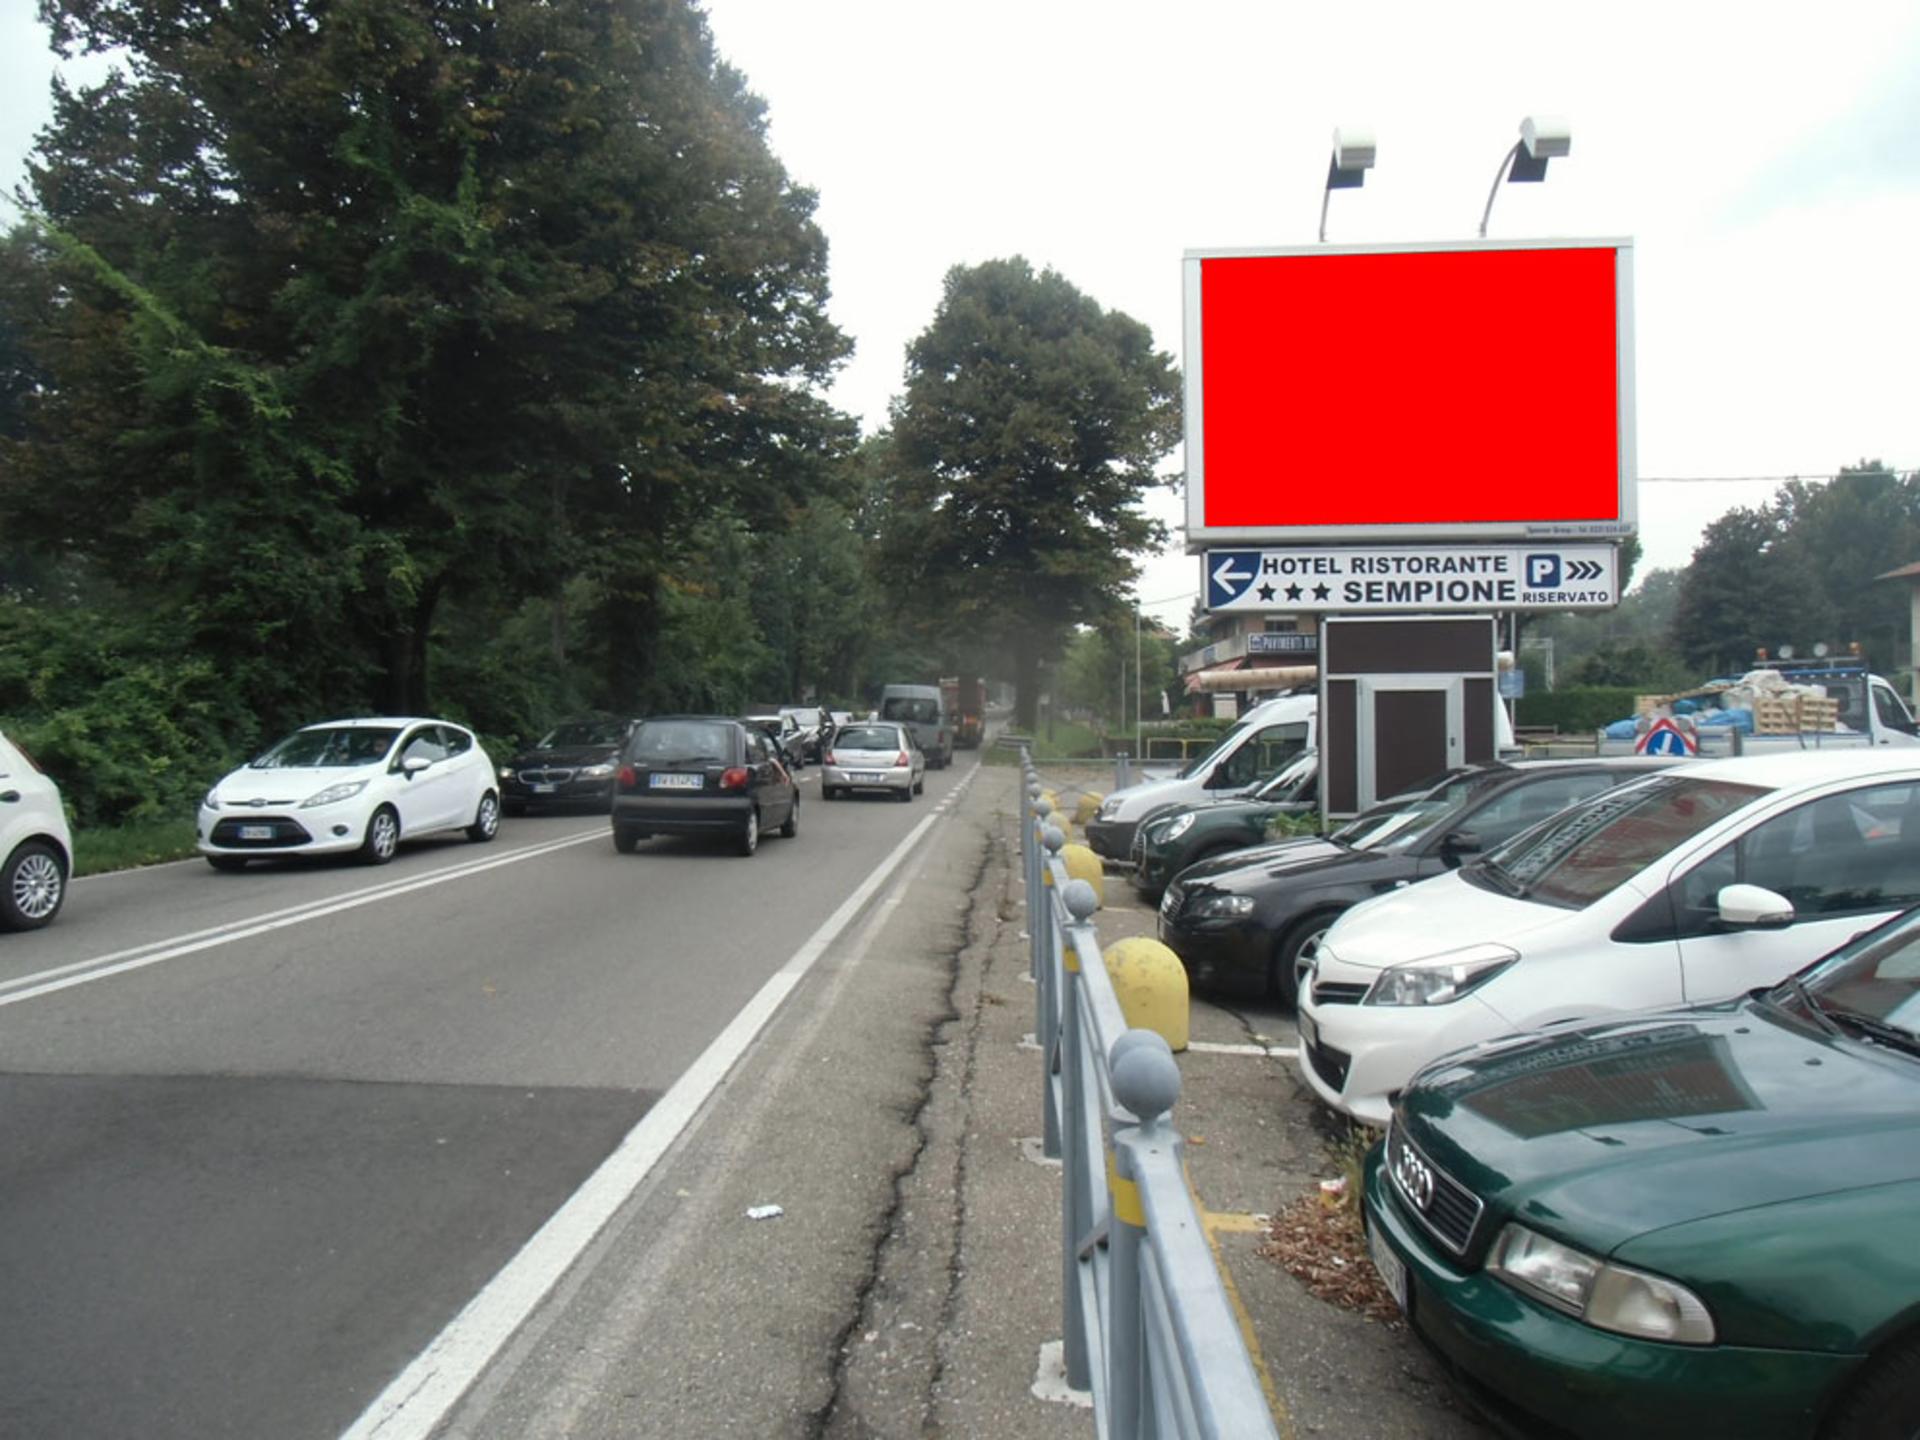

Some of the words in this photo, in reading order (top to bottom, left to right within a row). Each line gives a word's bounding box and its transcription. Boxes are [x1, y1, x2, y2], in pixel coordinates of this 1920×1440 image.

[1262, 557, 1342, 575] HOTEL
[1351, 556, 1508, 574] RISTORANTE
[1532, 559, 1556, 583] P
[1343, 580, 1516, 603] SEMPIONE
[1522, 591, 1609, 603] RISERVATO
